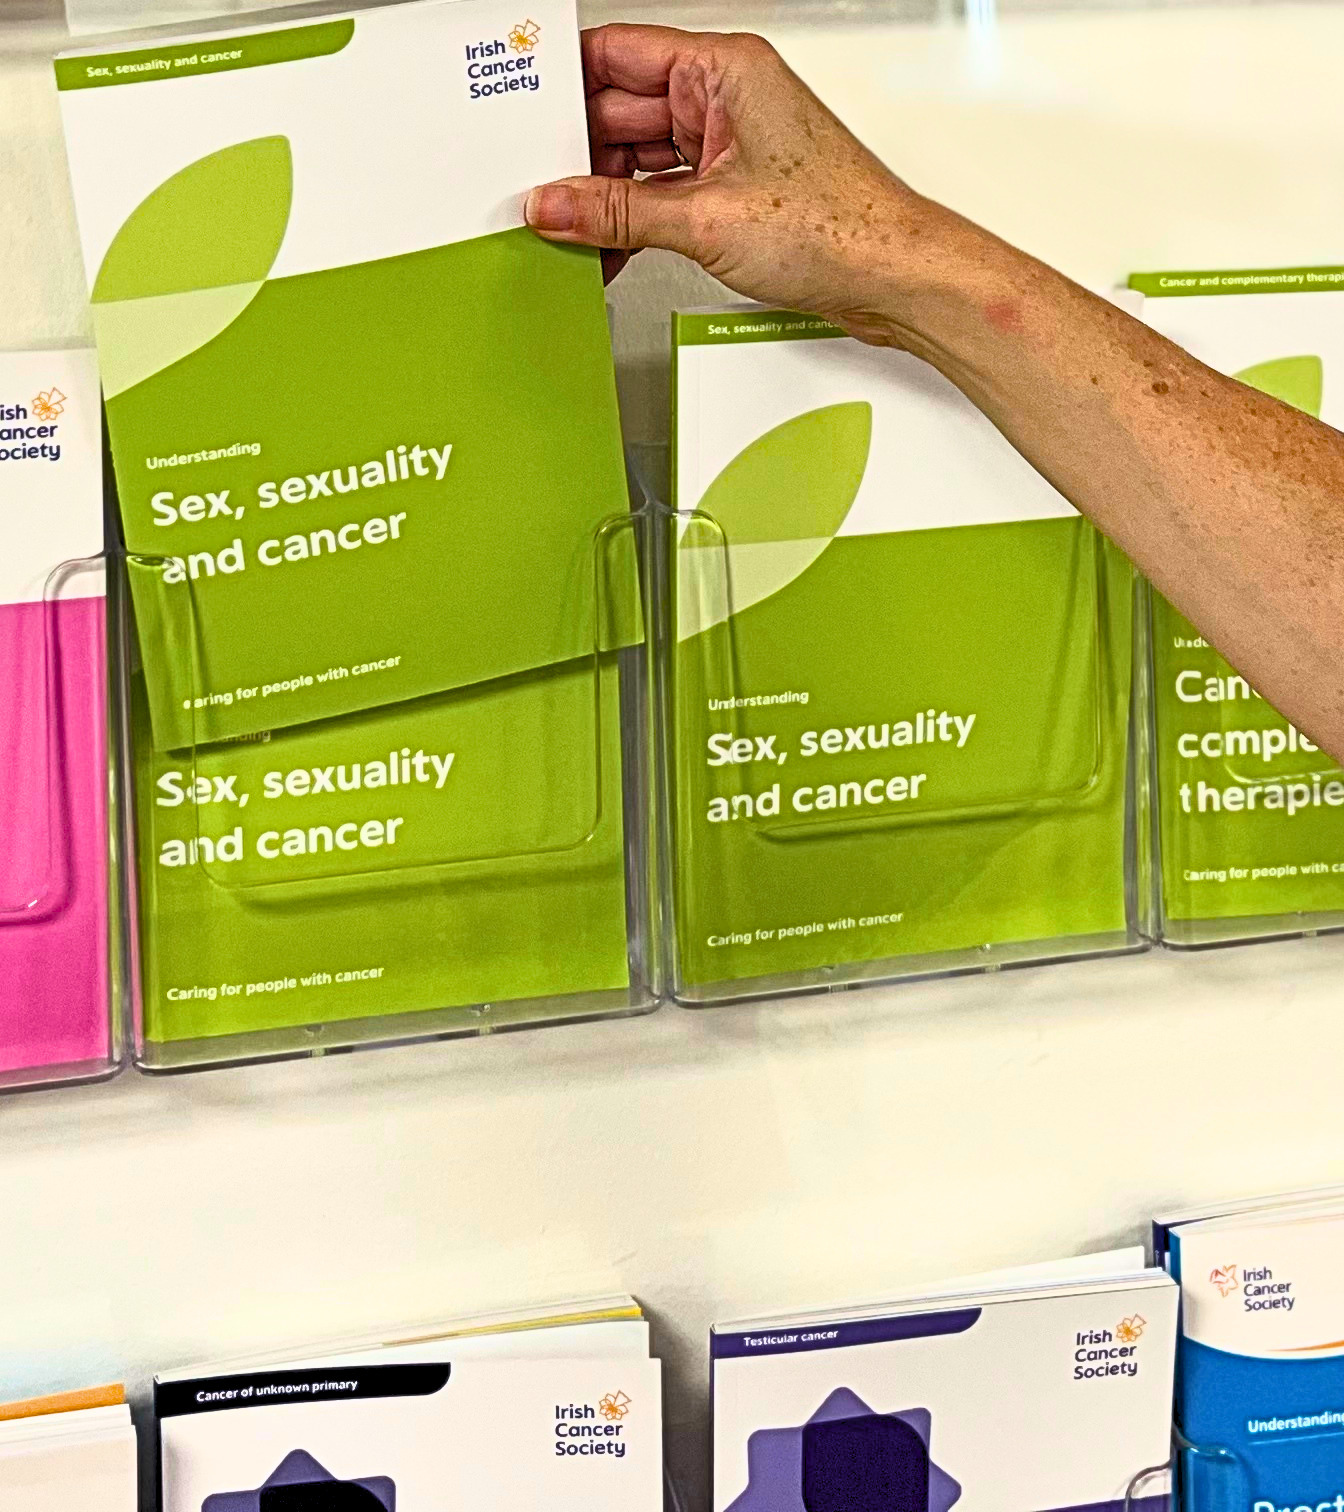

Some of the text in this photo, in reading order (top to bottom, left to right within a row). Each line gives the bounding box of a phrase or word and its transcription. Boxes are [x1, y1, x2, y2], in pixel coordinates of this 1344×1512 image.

[465, 40, 506, 61] Irish
[86, 48, 243, 79] Sex, sexuality and cancer
[467, 54, 535, 79] Cancer
[469, 74, 540, 99] Society
[1160, 275, 1194, 288] Cancer
[1197, 275, 1218, 287] and
[1221, 271, 1304, 288] complementary
[707, 325, 731, 336] Sex,
[733, 321, 783, 335] sexuality
[784, 319, 805, 331] and
[146, 441, 261, 469] Understanding
[152, 444, 453, 526] Sex, sexuality
[160, 509, 407, 584] and cancer
[799, 709, 977, 756] sexuality
[262, 748, 455, 798] sexuality
[256, 816, 404, 858] cancer
[1242, 1266, 1273, 1284] Irish
[1243, 1281, 1293, 1299] Cancer
[1243, 1295, 1296, 1313] Society
[743, 1328, 839, 1348] Testicular cancer
[196, 1379, 359, 1402] Cancer of unknown primary
[555, 1402, 596, 1422] Irish
[555, 1421, 624, 1440] Cancer
[555, 1438, 627, 1459] Society
